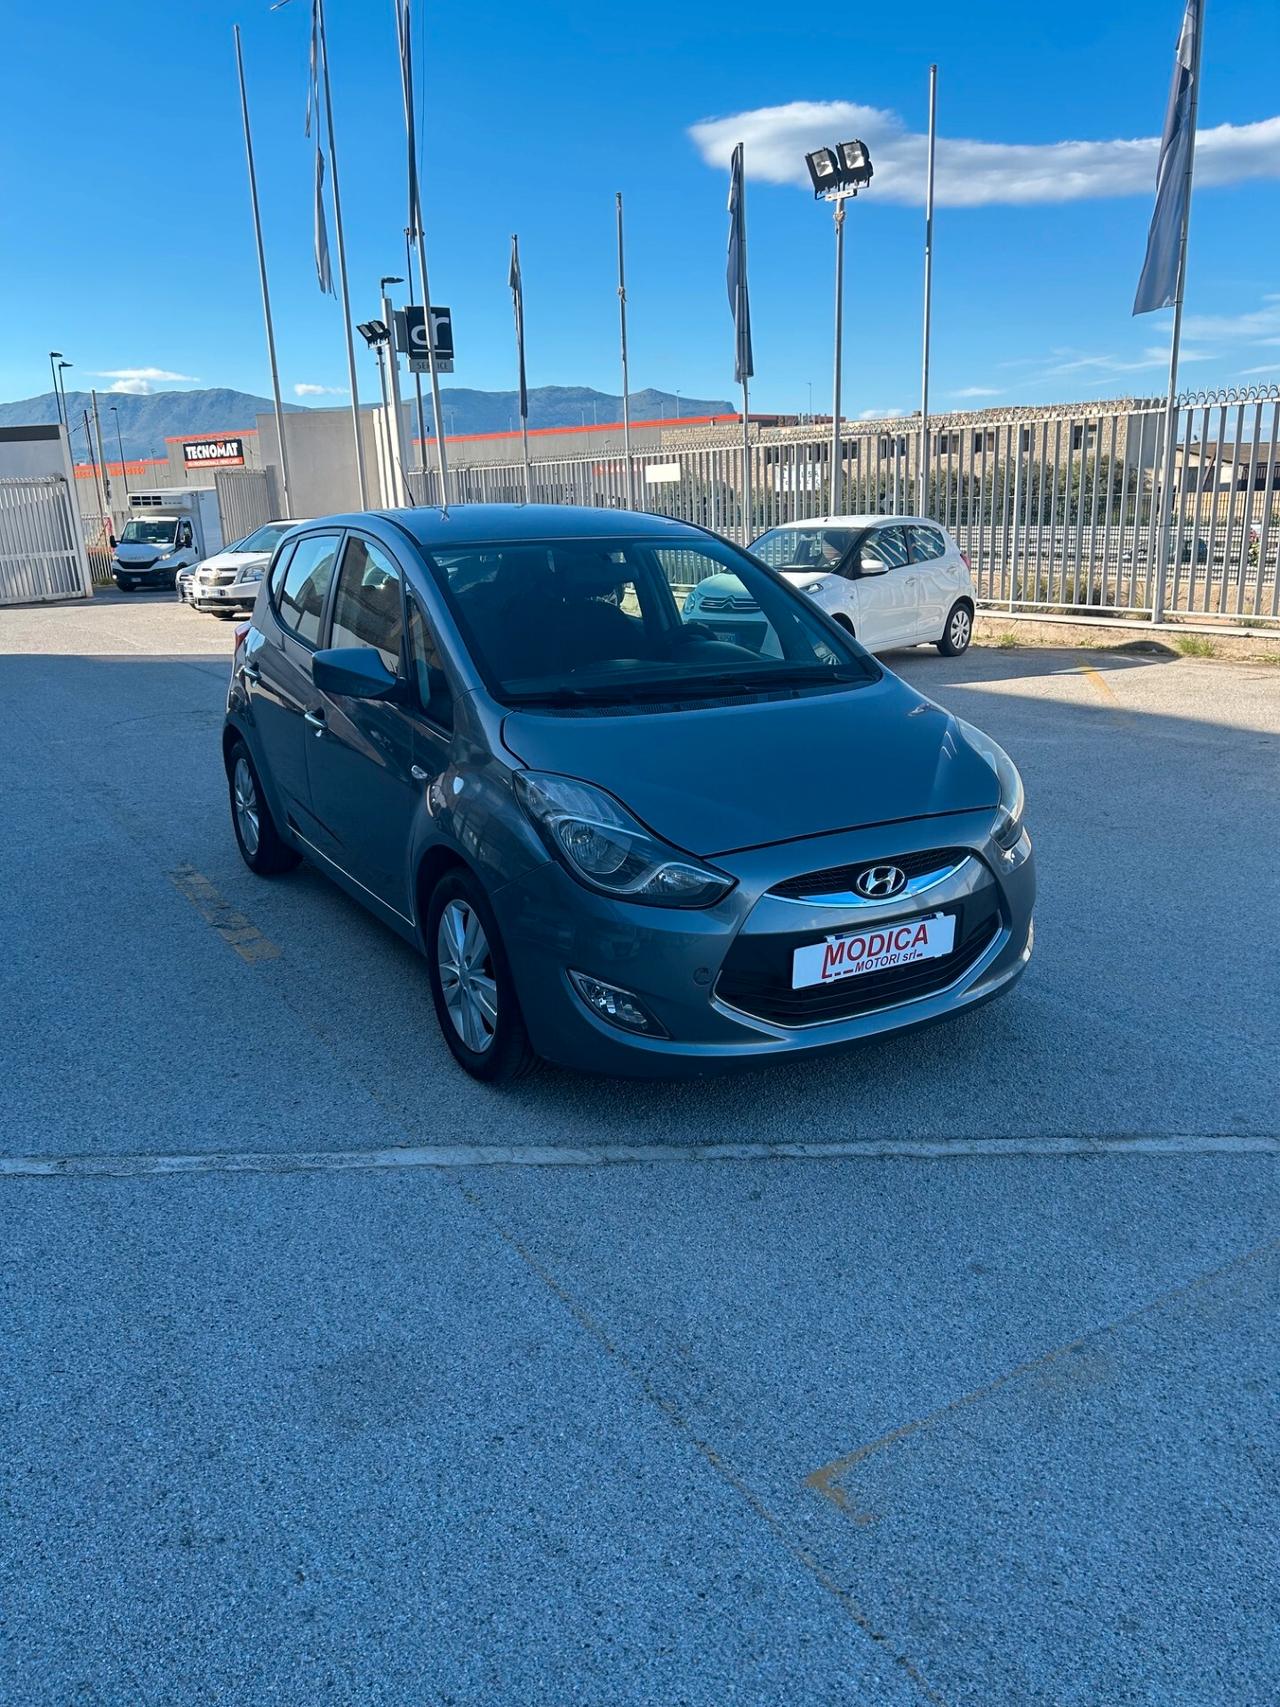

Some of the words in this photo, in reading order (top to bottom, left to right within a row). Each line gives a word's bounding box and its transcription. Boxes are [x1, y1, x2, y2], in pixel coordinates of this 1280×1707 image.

[416, 360, 449, 370] SEICE
[185, 442, 238, 460] TECNOMAT
[822, 924, 928, 978] MODICA
[855, 953, 900, 973] MOTORI
[903, 949, 917, 962] srl
